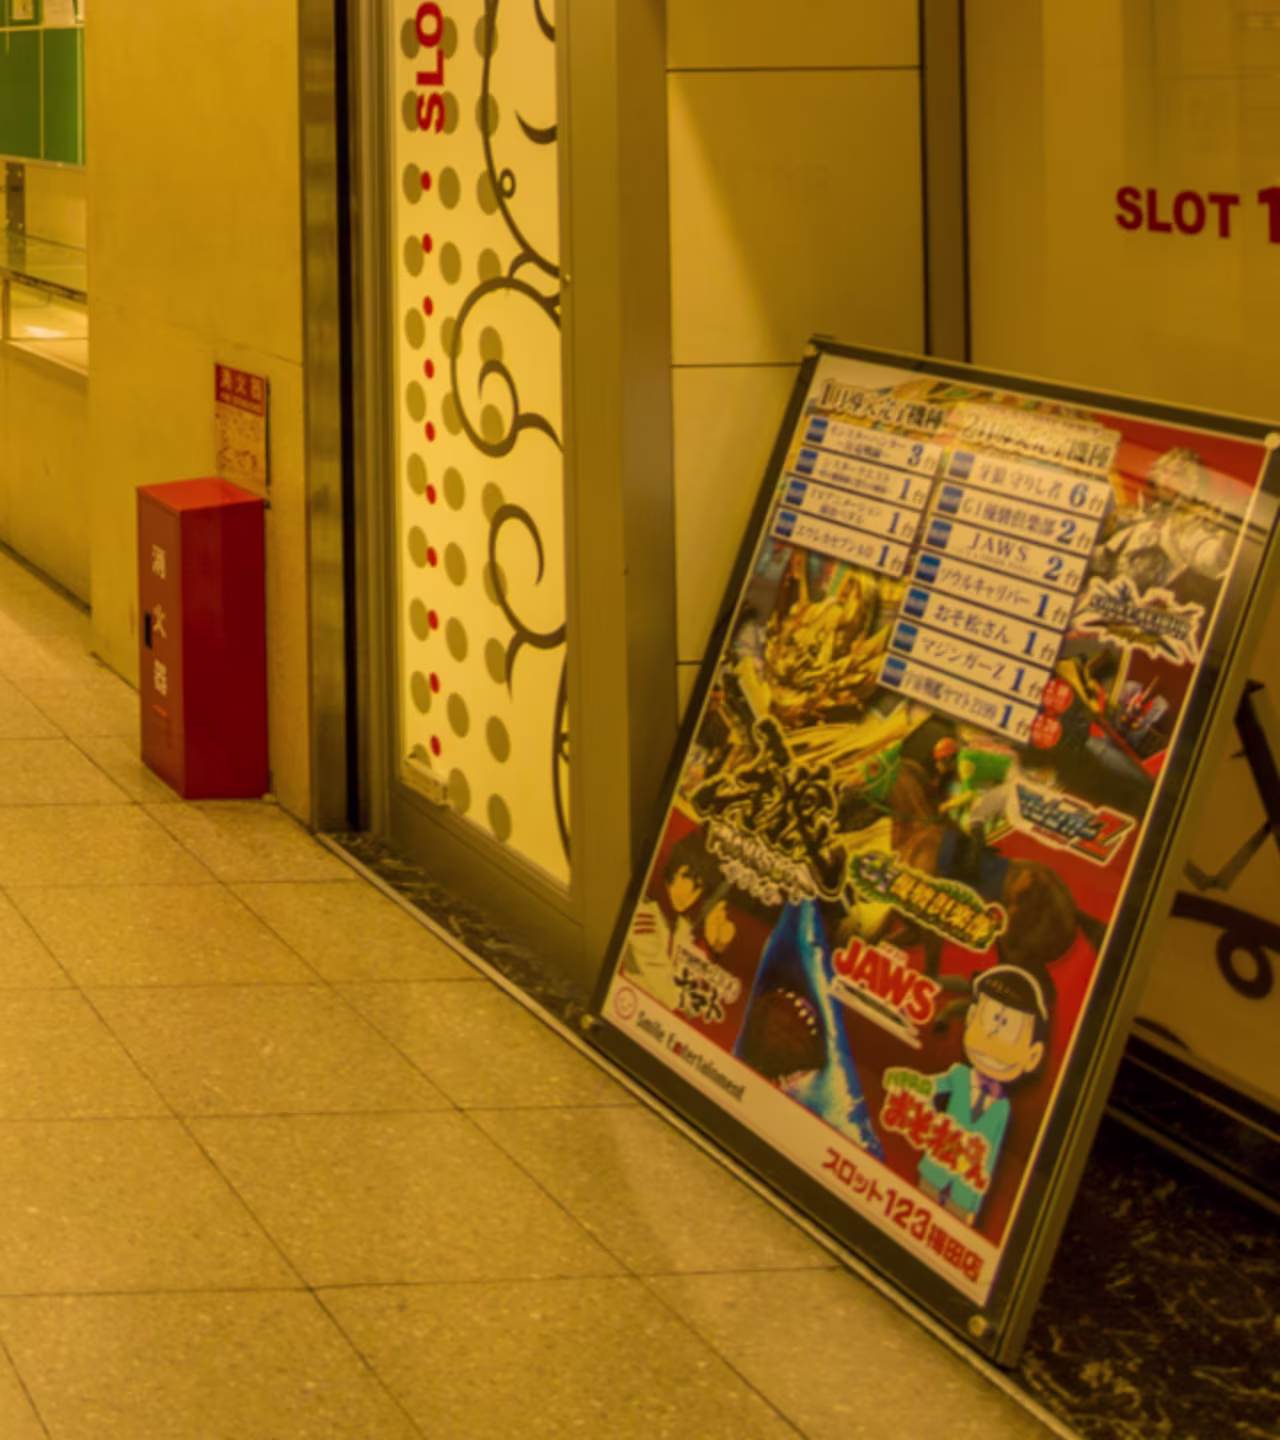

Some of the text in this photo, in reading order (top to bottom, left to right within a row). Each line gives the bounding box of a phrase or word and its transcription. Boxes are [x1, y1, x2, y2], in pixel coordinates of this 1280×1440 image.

[1115, 185, 1241, 240] SLOT
[968, 531, 1029, 563] JAWS
[933, 604, 1011, 646] おそ松さん
[833, 938, 938, 1023] JAWS
